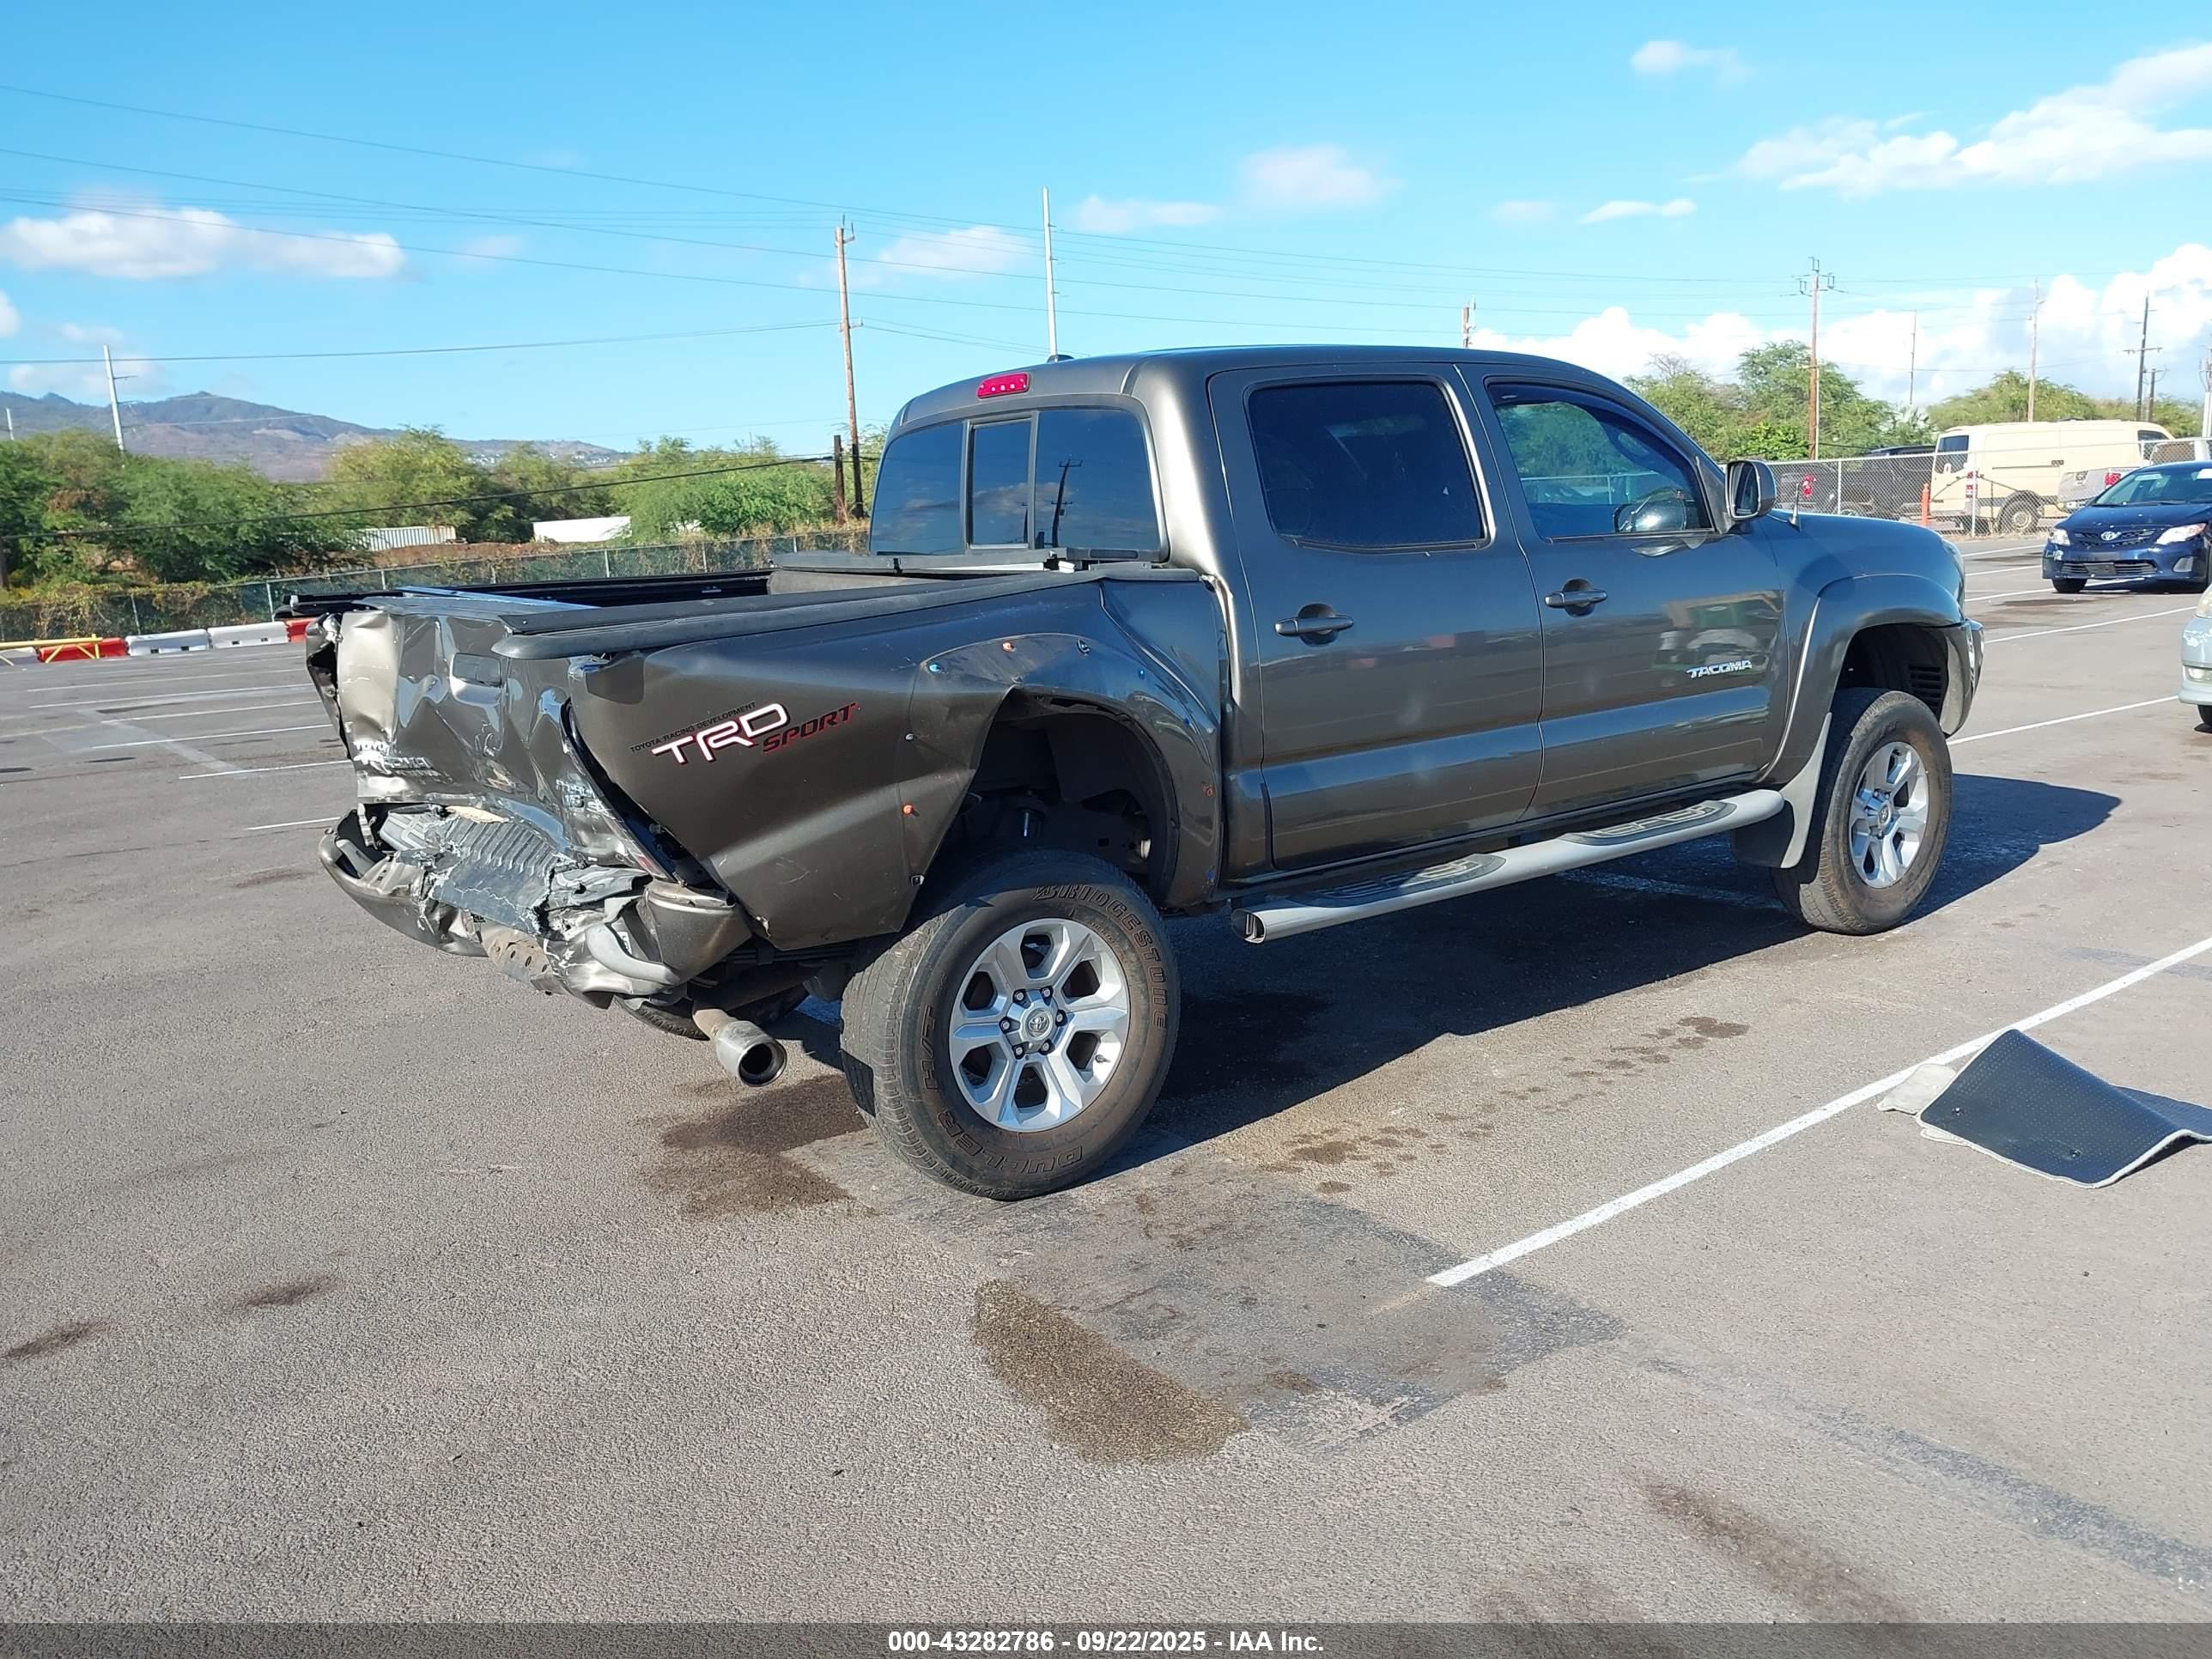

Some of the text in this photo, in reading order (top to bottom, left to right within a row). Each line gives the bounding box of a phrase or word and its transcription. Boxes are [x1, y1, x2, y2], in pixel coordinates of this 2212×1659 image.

[1686, 659, 1753, 679] TACOMA
[353, 740, 394, 757] TOYO
[629, 701, 757, 753] TOYOTA RACING DEVELOPMENT
[651, 702, 857, 765] TRD SPORT
[1033, 884, 1169, 1030] BRIDGESTONE
[920, 1004, 1083, 1175] DUELER H/T
